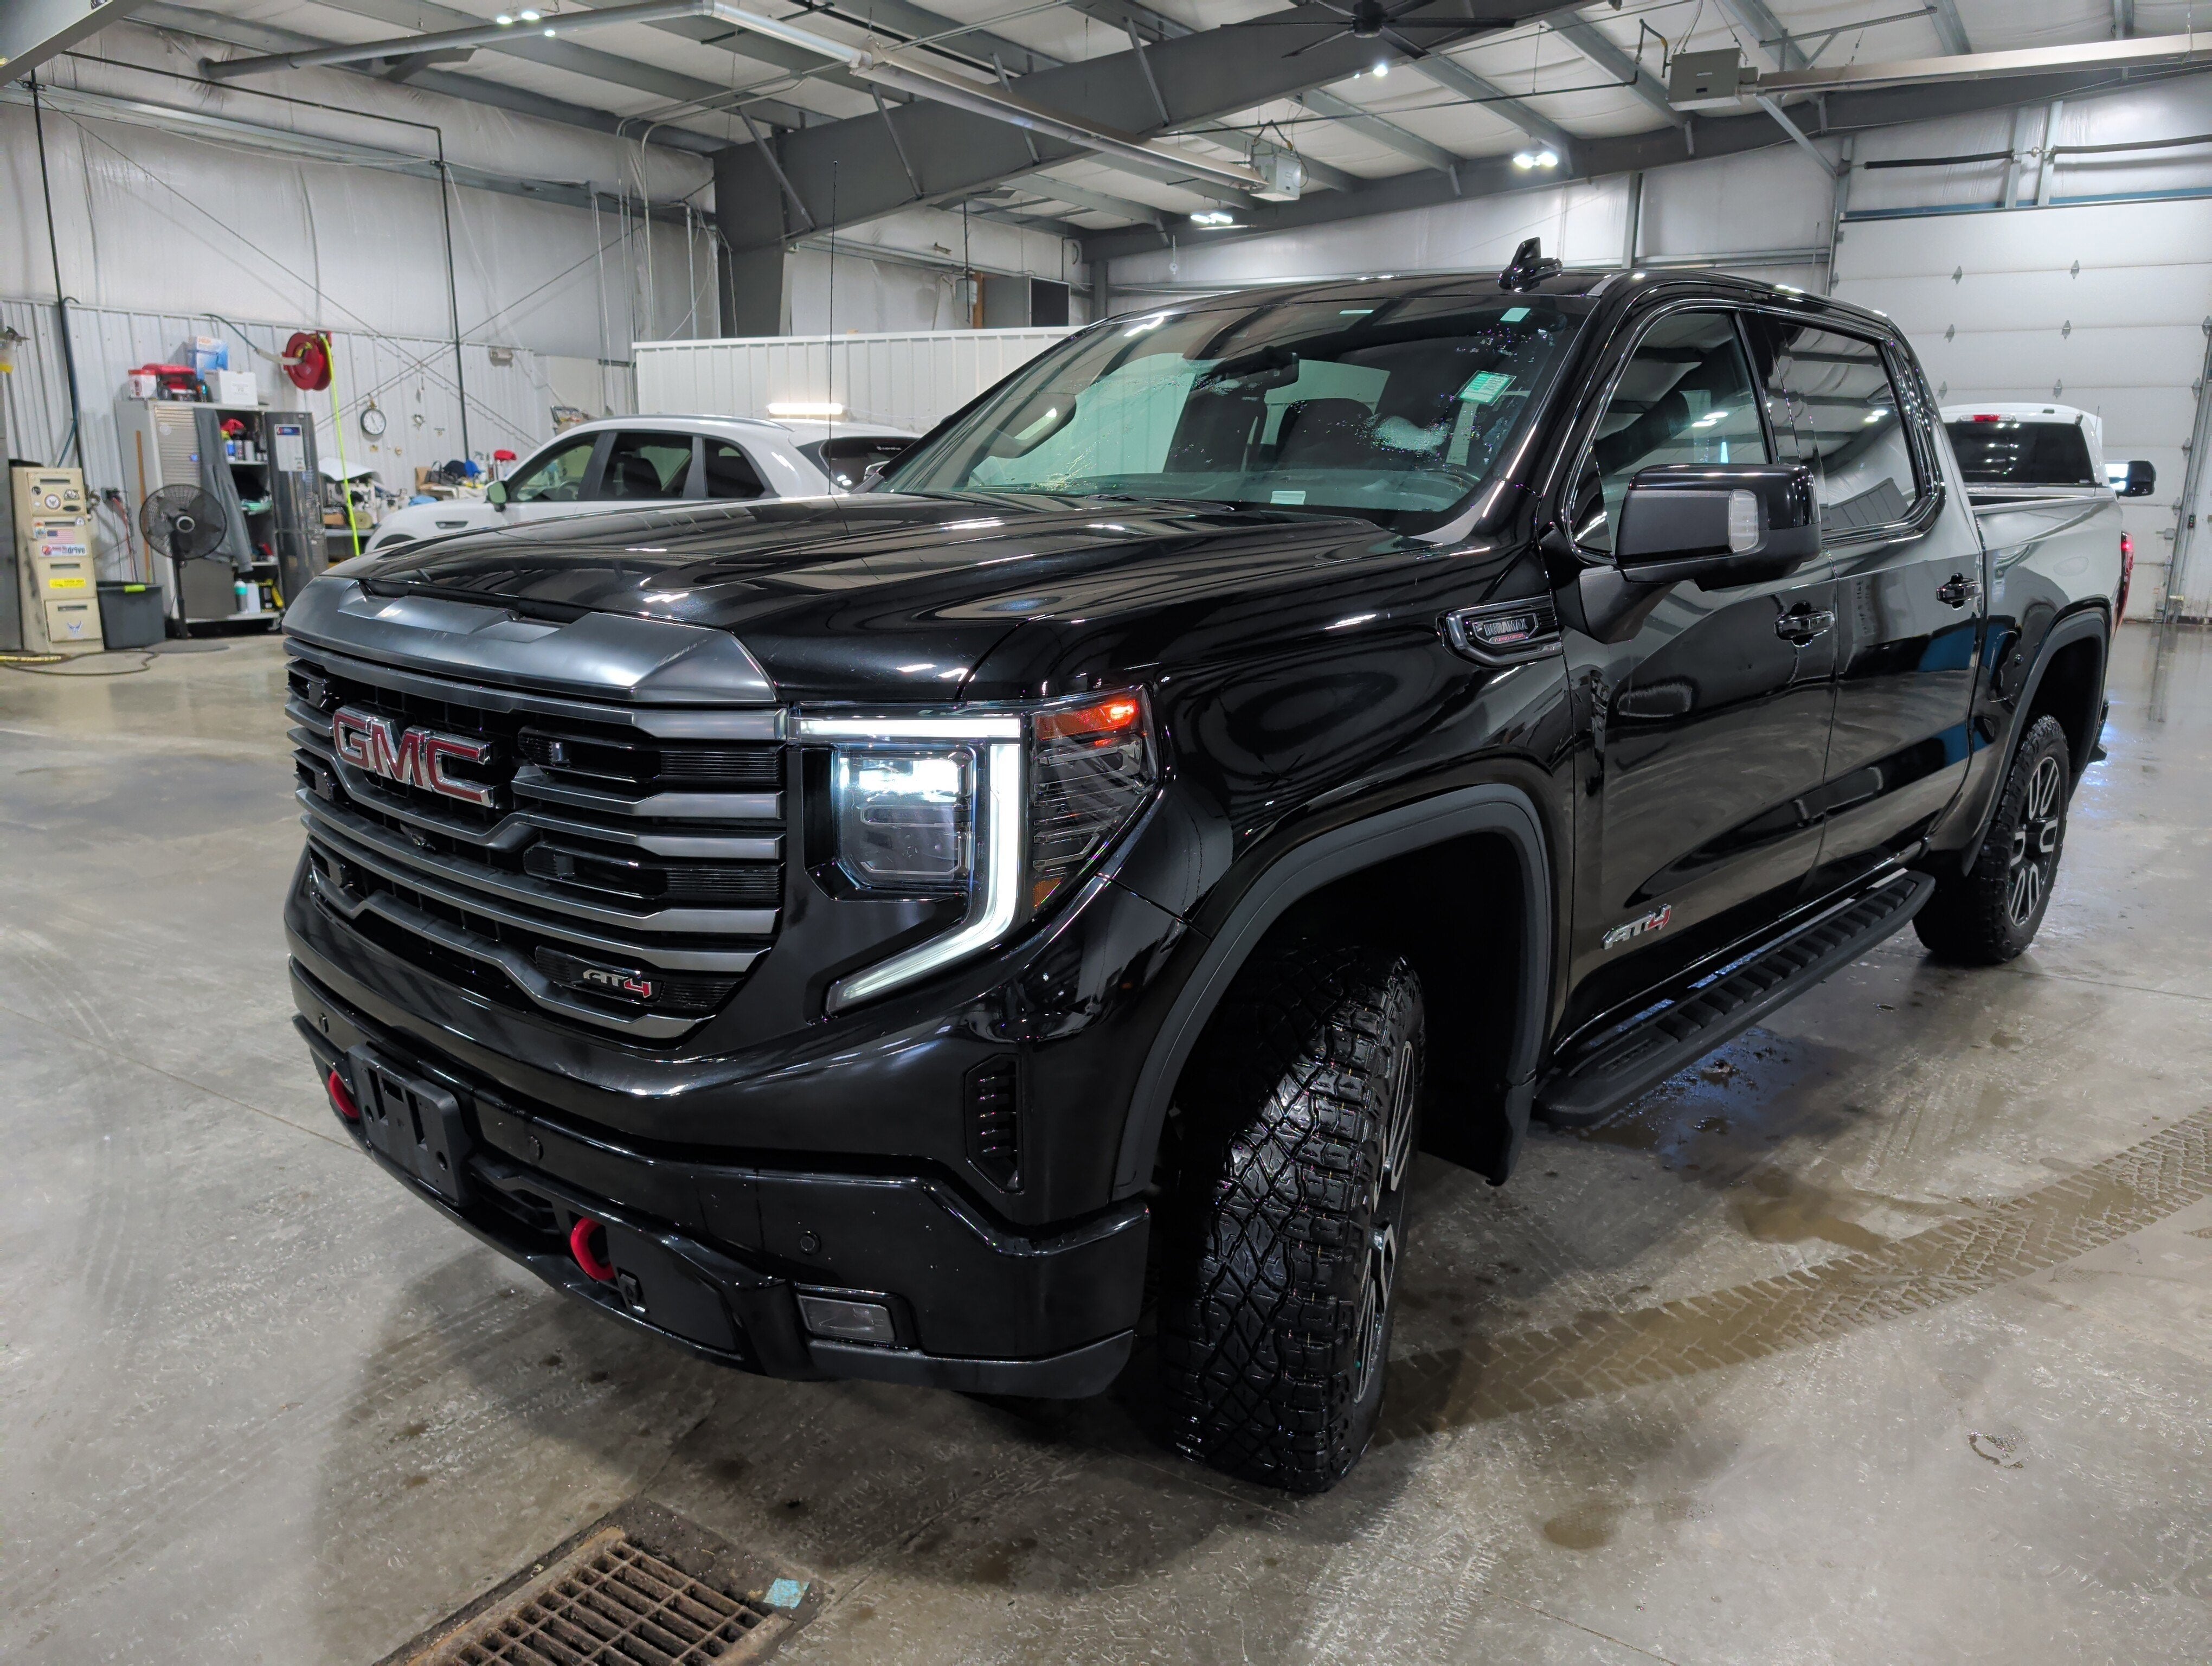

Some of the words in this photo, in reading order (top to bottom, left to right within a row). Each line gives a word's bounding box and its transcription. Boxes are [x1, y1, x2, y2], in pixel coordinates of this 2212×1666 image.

[1483, 618, 1528, 636] DURAMAX
[333, 706, 494, 808] GMC
[1602, 904, 1671, 950] AT4
[583, 969, 652, 998] AT4
